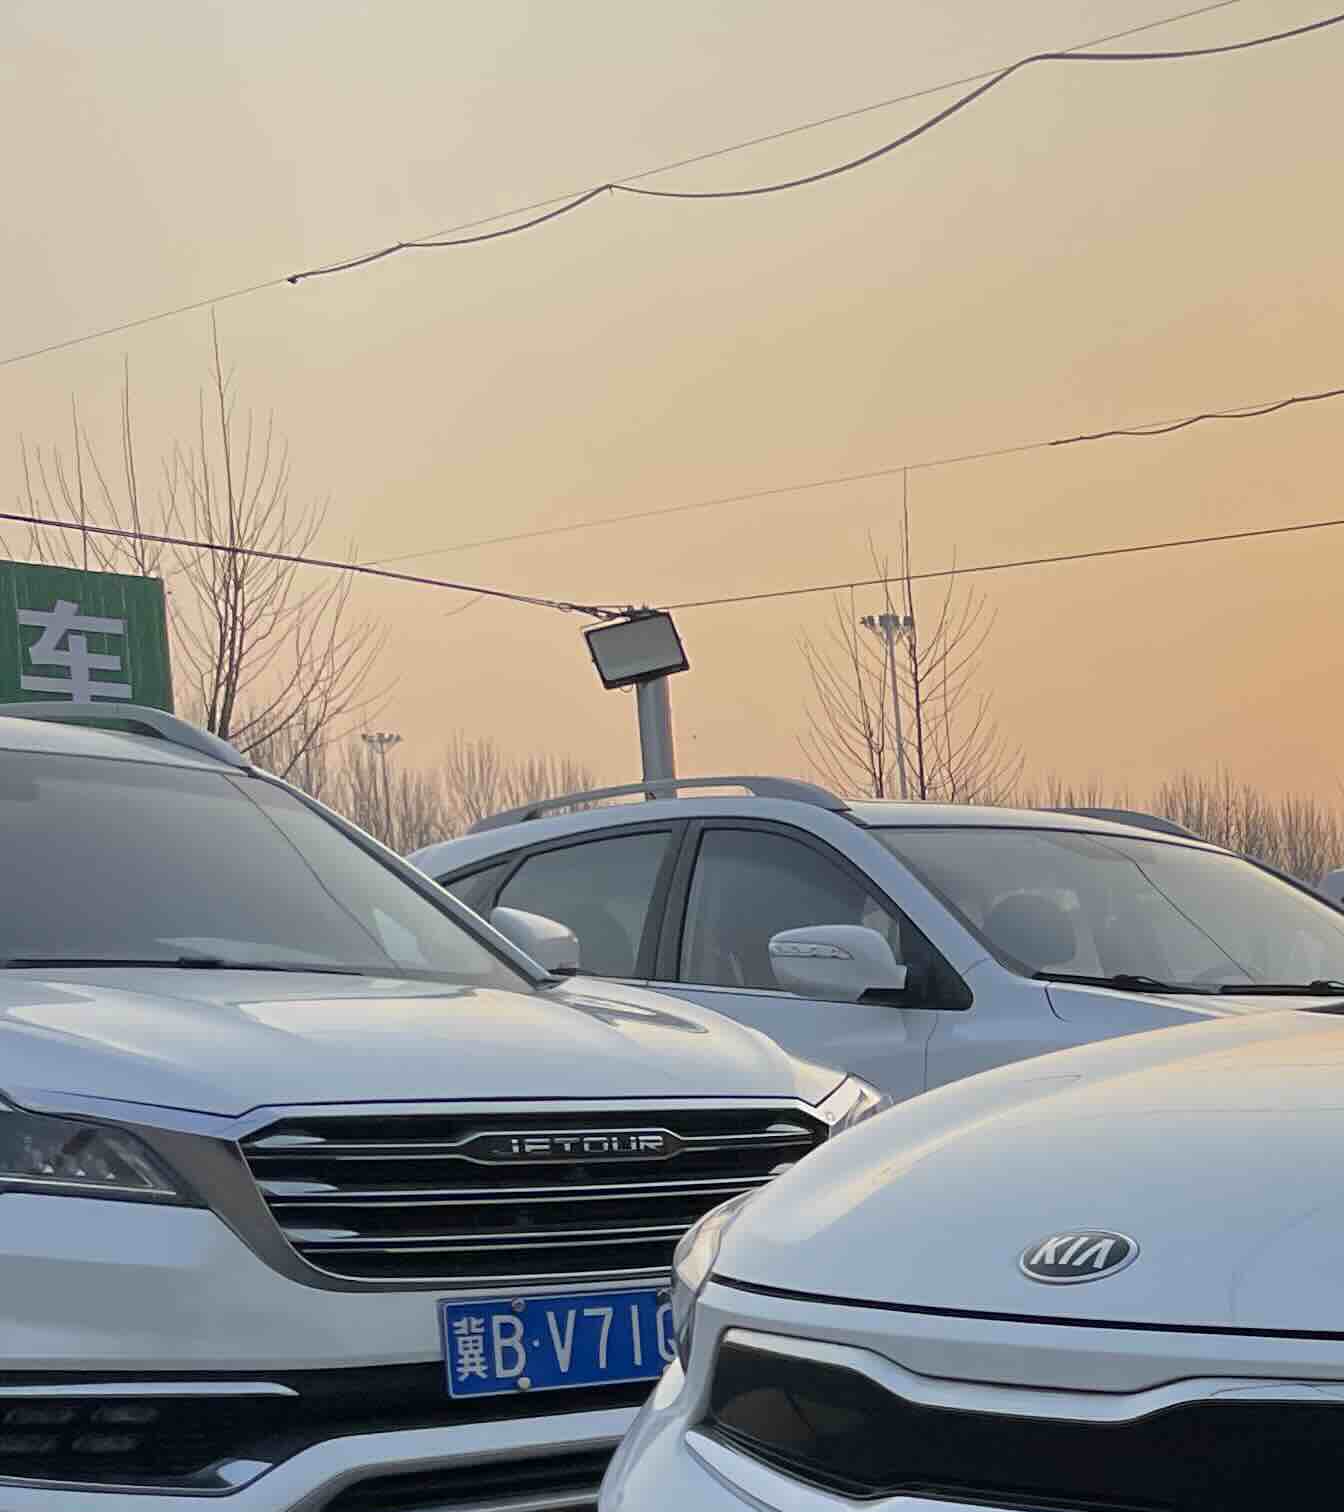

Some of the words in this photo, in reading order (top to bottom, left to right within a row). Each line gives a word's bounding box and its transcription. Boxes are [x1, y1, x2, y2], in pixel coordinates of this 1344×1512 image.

[16, 599, 133, 704] 车
[511, 1135, 664, 1156] JETOUR
[1030, 1236, 1116, 1269] KIA
